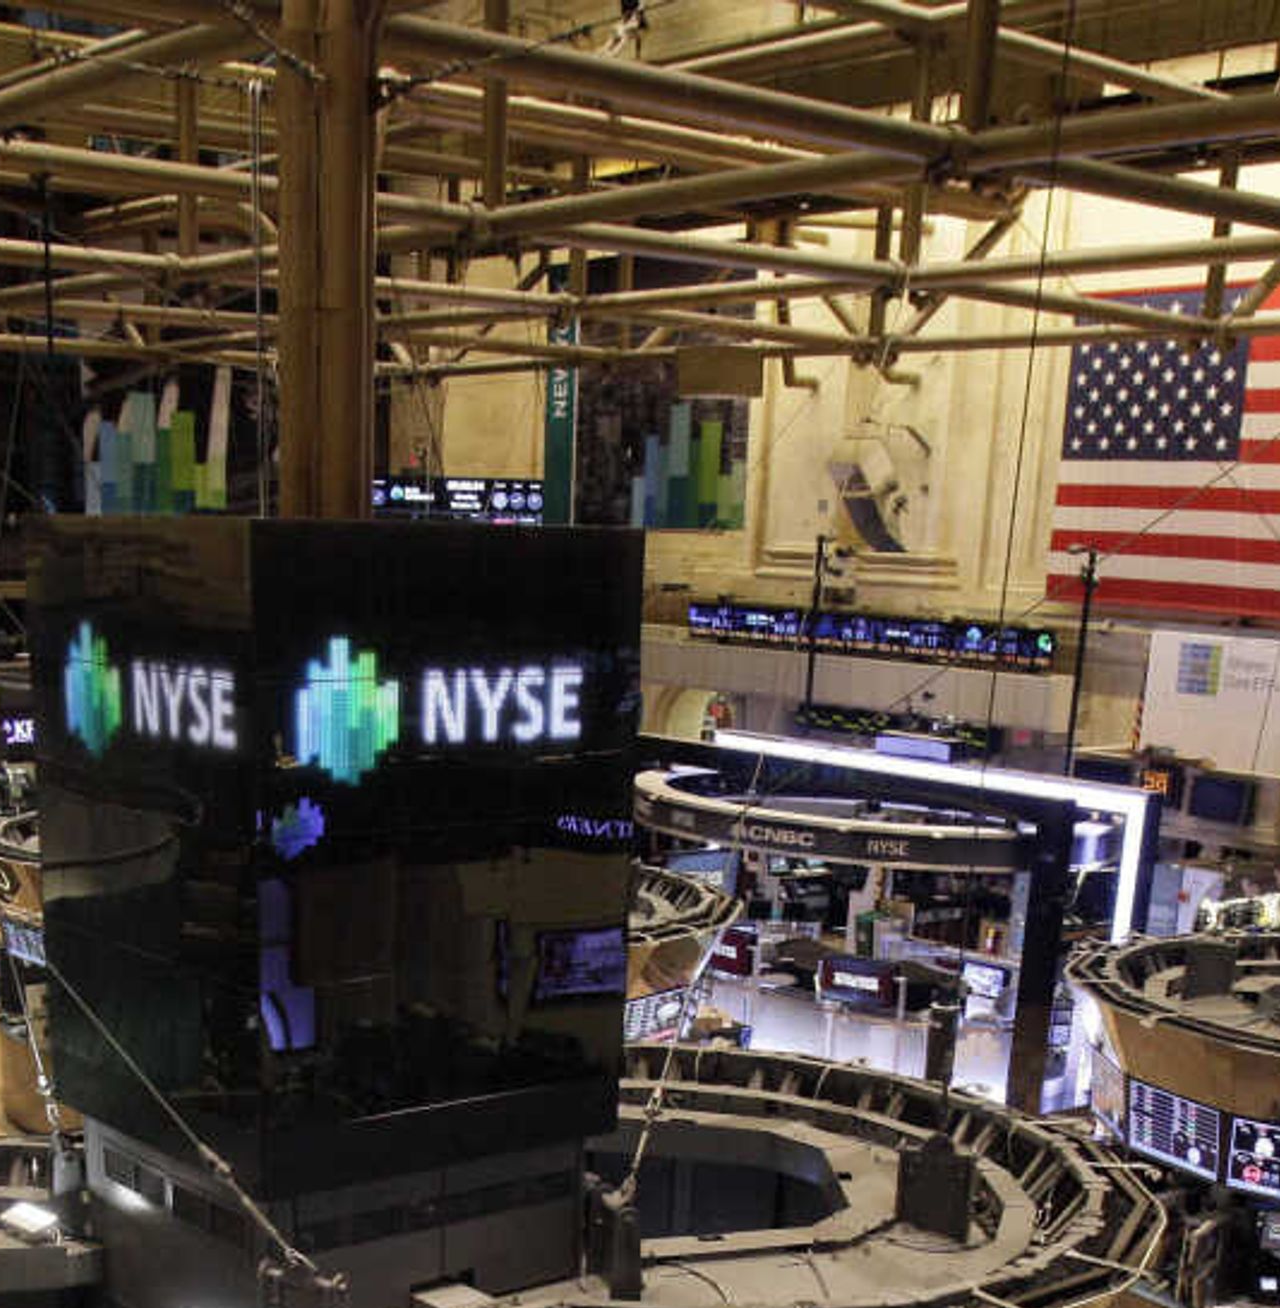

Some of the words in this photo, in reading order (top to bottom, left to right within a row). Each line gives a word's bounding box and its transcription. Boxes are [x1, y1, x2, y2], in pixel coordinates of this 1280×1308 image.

[132, 660, 238, 749] NYSE
[423, 666, 583, 743] NYSE
[749, 826, 814, 846] CNBC
[869, 839, 910, 856] NYSE
